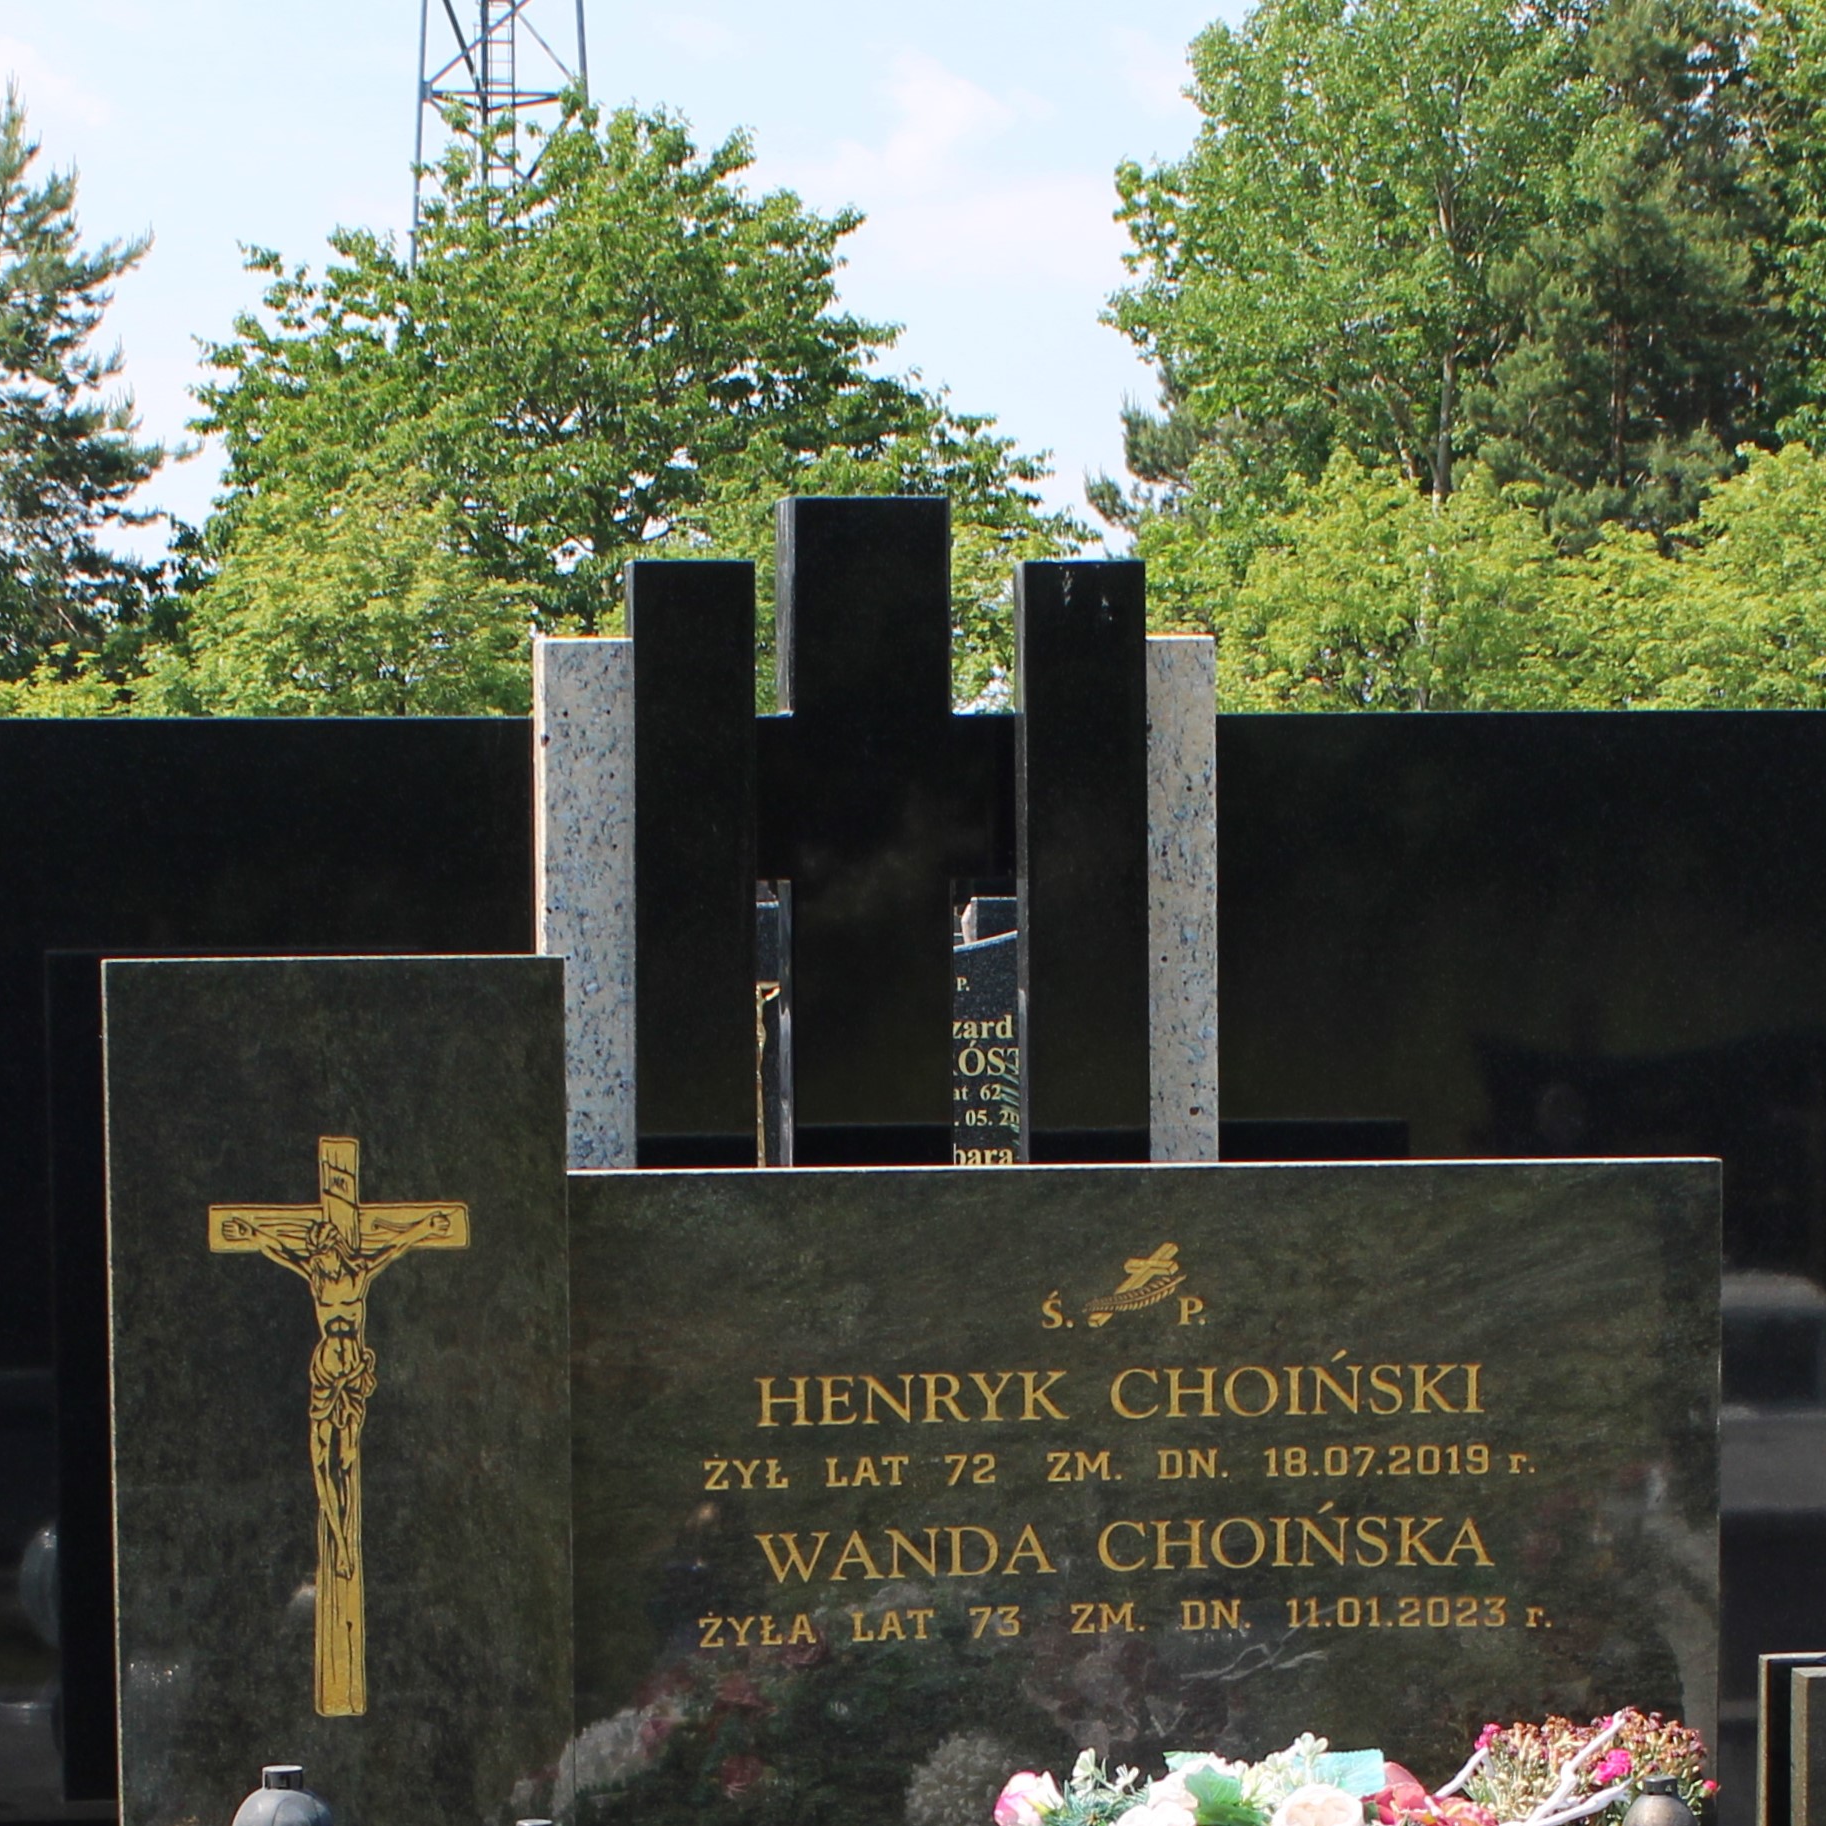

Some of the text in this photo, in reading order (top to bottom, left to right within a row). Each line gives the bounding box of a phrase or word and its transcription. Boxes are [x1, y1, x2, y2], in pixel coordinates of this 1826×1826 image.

[956, 976, 970, 992] P.
[953, 1039, 1020, 1077] ÓST
[980, 1084, 1002, 1101] 62
[1042, 1291, 1206, 1329] Ś. P.
[755, 1349, 1485, 1427] HENRYK CHOIŃSKI
[703, 1443, 1536, 1490] ŻYŁ LAT 72 ZM. DN. 18.07.2019 r.
[755, 1501, 1495, 1583] WANDA CHOIŃSKA
[698, 1596, 1552, 1648] ŻYŁA LAT 73 ZM. DN. 11.01.2023 r.
